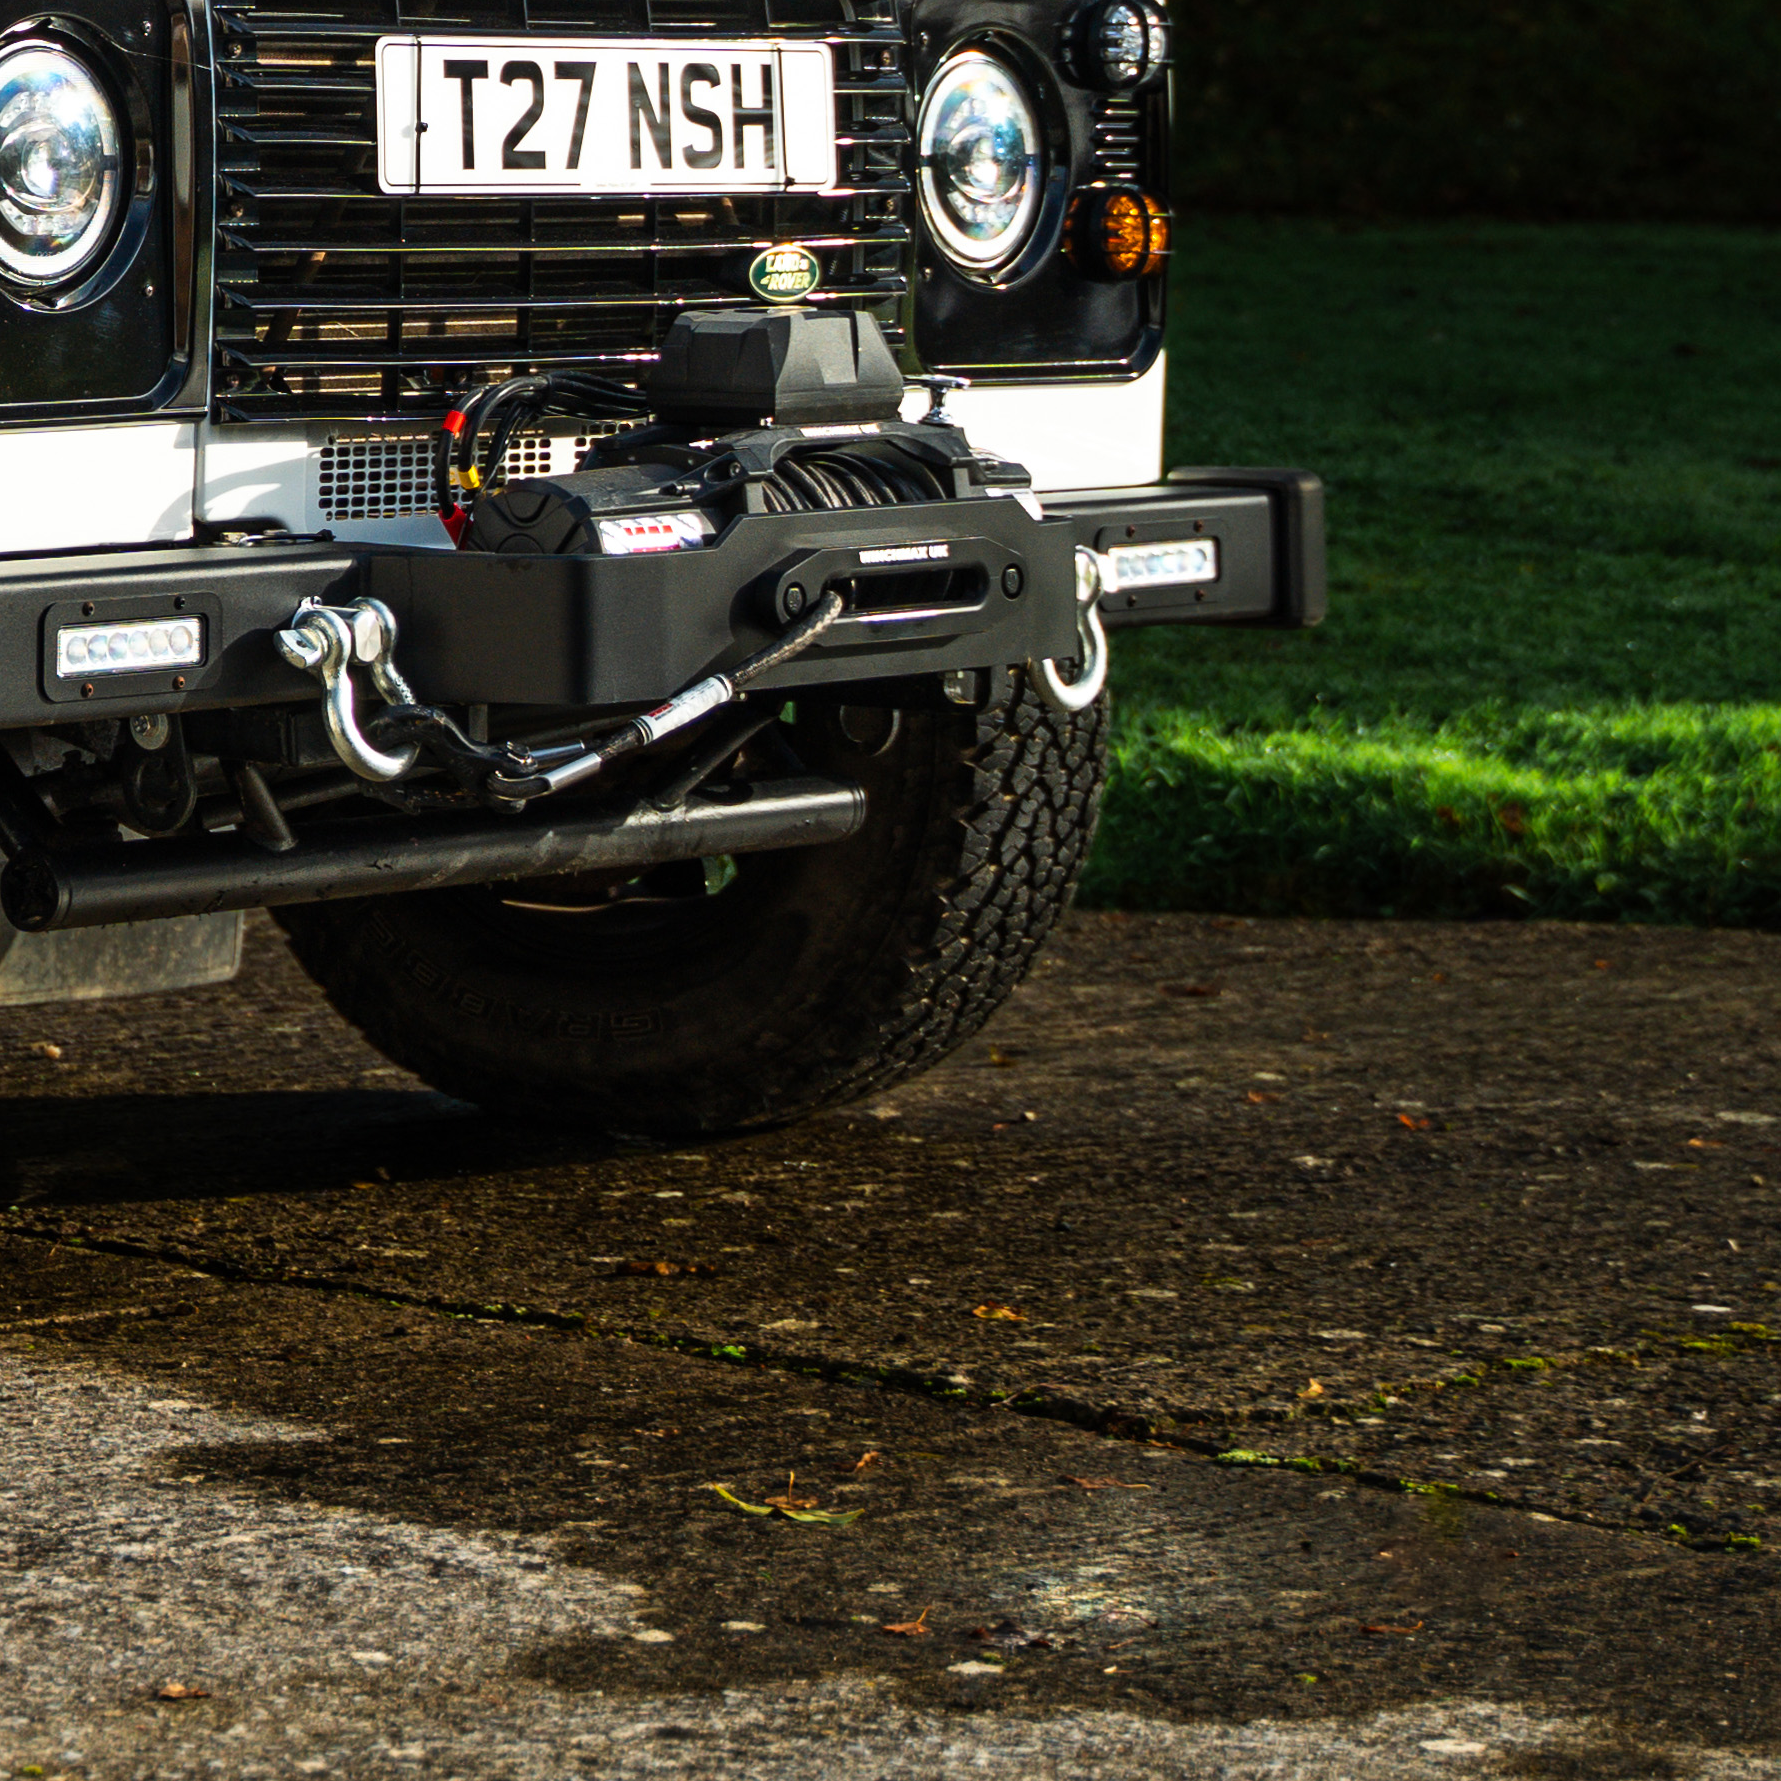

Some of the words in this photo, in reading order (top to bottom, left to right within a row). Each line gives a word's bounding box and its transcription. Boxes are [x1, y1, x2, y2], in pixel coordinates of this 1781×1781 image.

[443, 59, 597, 170] T27
[627, 61, 776, 170] NSH
[765, 253, 801, 272] LAND
[767, 272, 810, 291] ROVER
